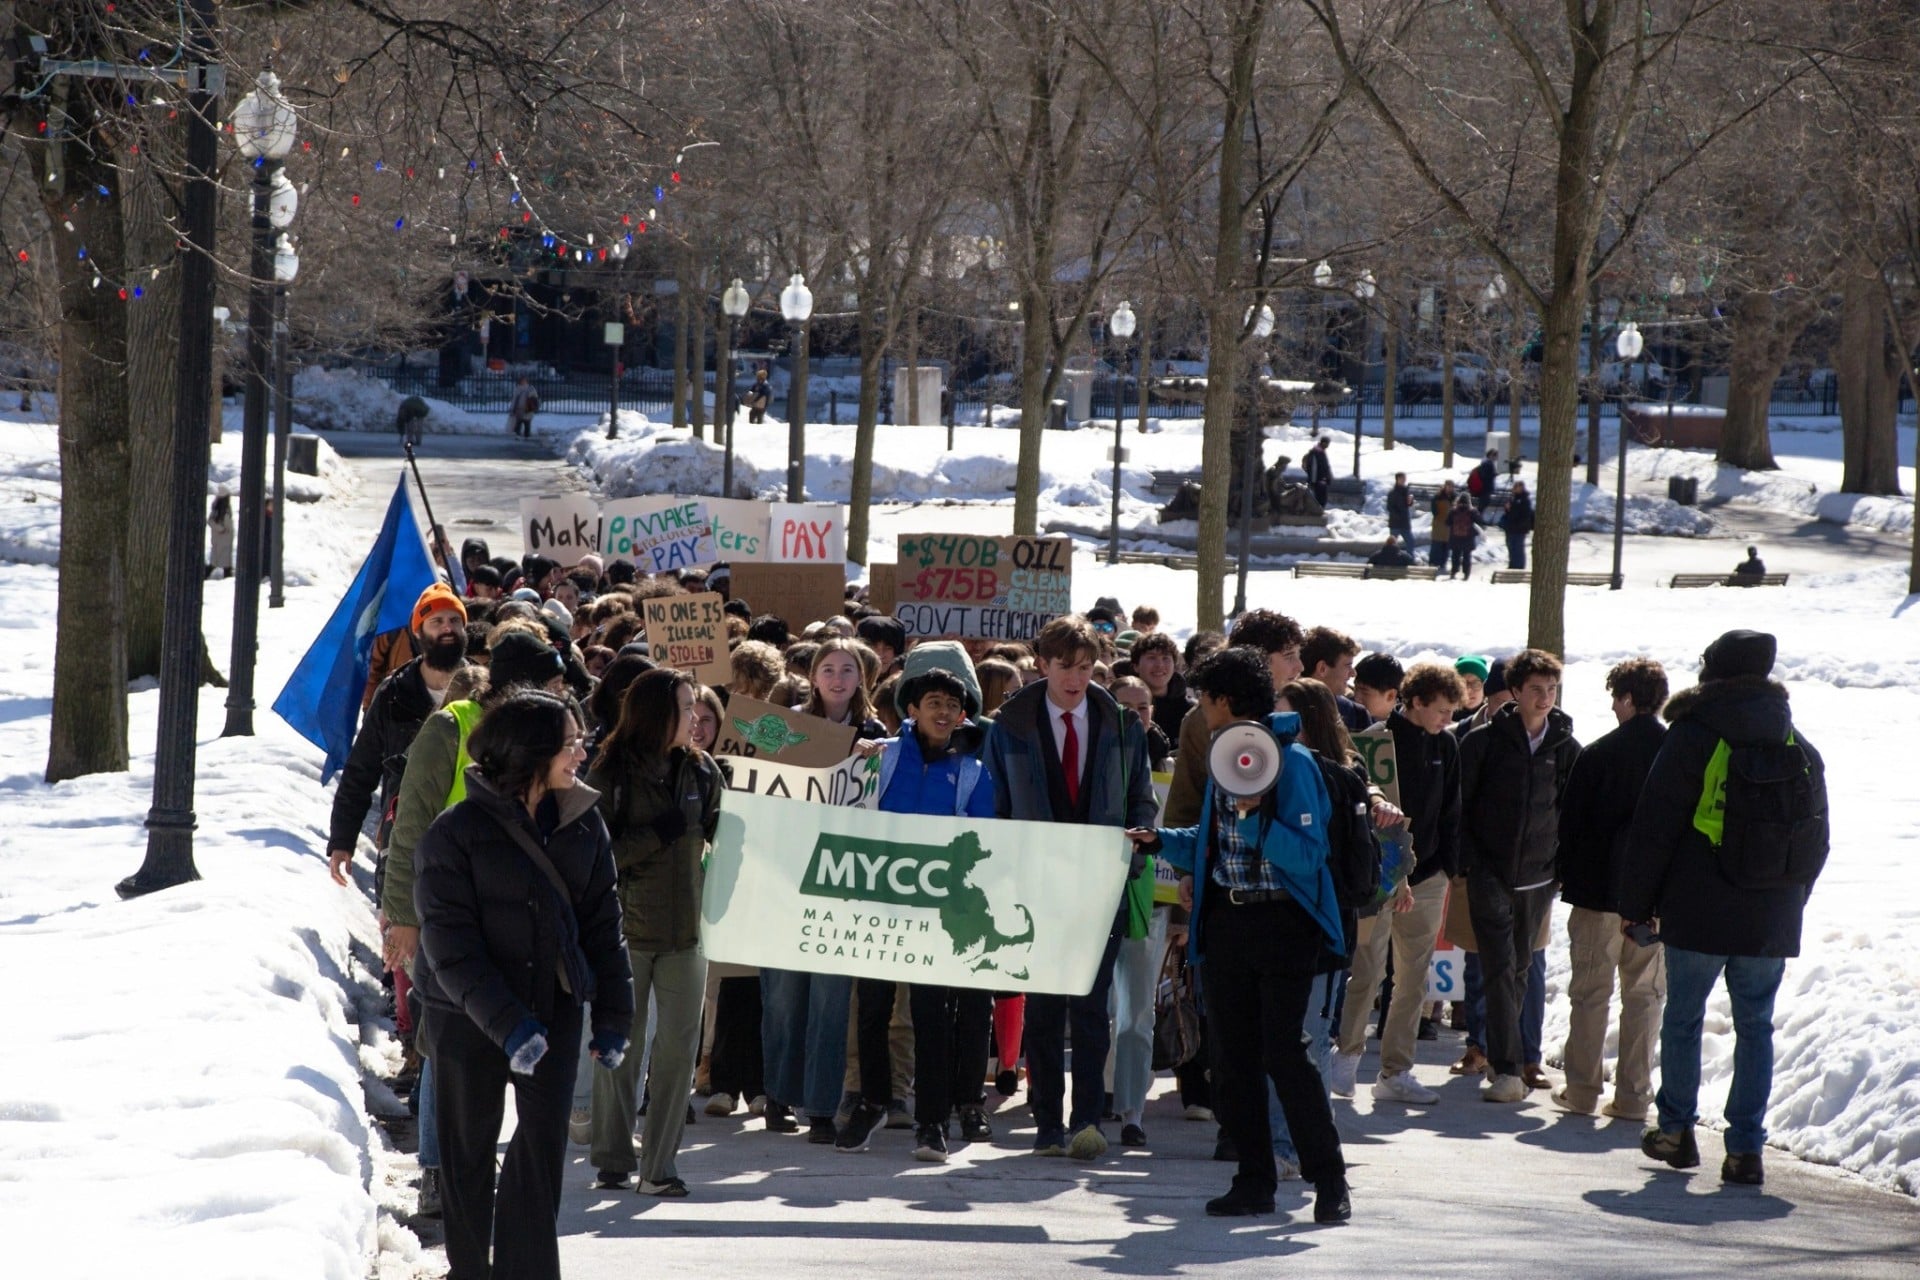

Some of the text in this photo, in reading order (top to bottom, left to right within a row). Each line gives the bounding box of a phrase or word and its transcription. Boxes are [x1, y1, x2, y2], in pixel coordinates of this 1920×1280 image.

[633, 502, 703, 538] MAKE
[607, 514, 760, 554] Poters
[782, 519, 832, 559] PAY
[651, 536, 699, 570] PAY
[1012, 539, 1065, 571] OIL
[1011, 568, 1071, 593] CLEAN
[648, 601, 722, 624] NO ONE IS
[981, 608, 1056, 641] EFFICIEN
[653, 643, 714, 664] ON STOLEN
[720, 737, 757, 757] SAD
[815, 848, 951, 898] MYCC
[803, 908, 929, 932] MA YOUTH
[801, 925, 905, 946] CLIMATE
[799, 942, 934, 966] COALITION
